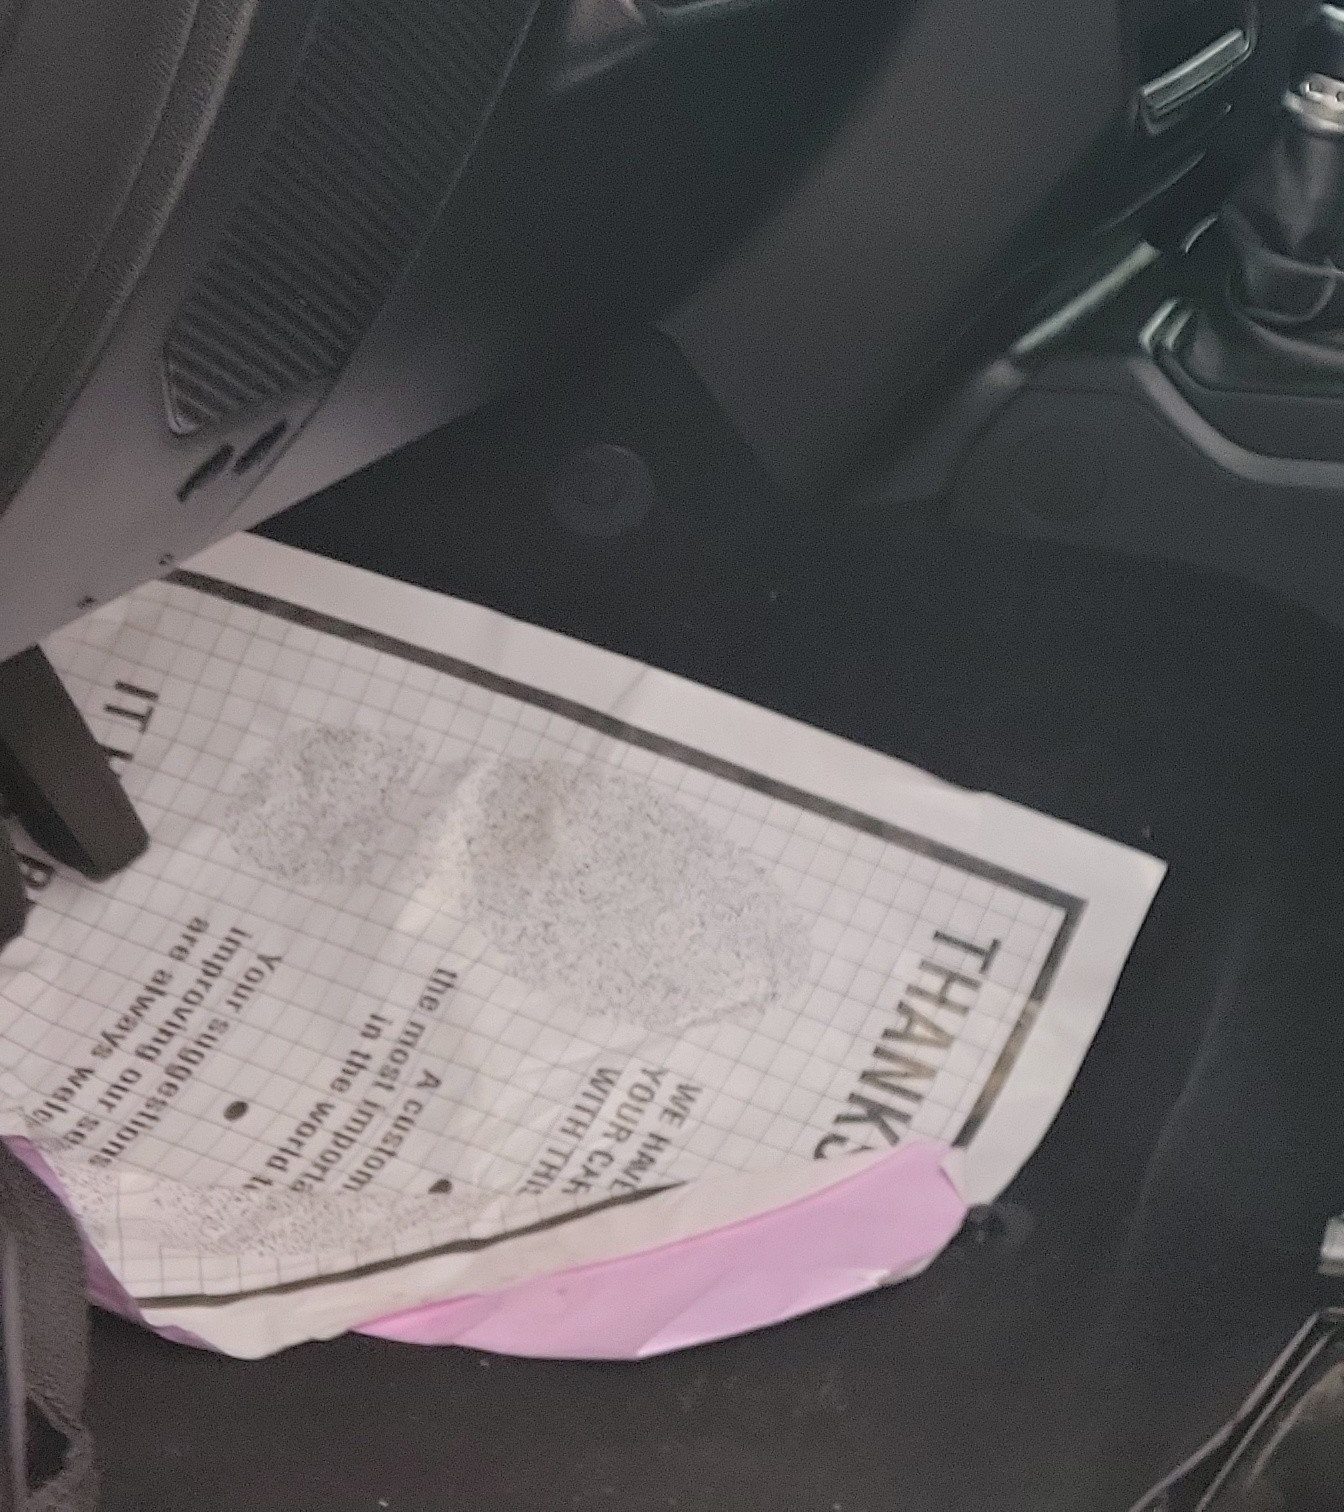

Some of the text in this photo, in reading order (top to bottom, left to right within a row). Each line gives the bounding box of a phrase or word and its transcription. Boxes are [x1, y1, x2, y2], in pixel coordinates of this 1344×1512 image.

[102, 680, 160, 734] IT
[167, 914, 211, 964] are
[90, 968, 171, 1061] always
[135, 925, 253, 1064] improving
[416, 966, 460, 1014] the
[359, 1012, 394, 1043] in
[87, 949, 283, 1171] Your suggestions
[330, 1048, 374, 1095] the
[372, 1020, 426, 1092] most
[415, 1068, 443, 1089] A
[96, 1067, 141, 1114] our
[560, 1067, 621, 1141] WITH
[602, 1067, 670, 1144] YOUR
[658, 1082, 703, 1129] WE
[266, 1100, 336, 1172] world
